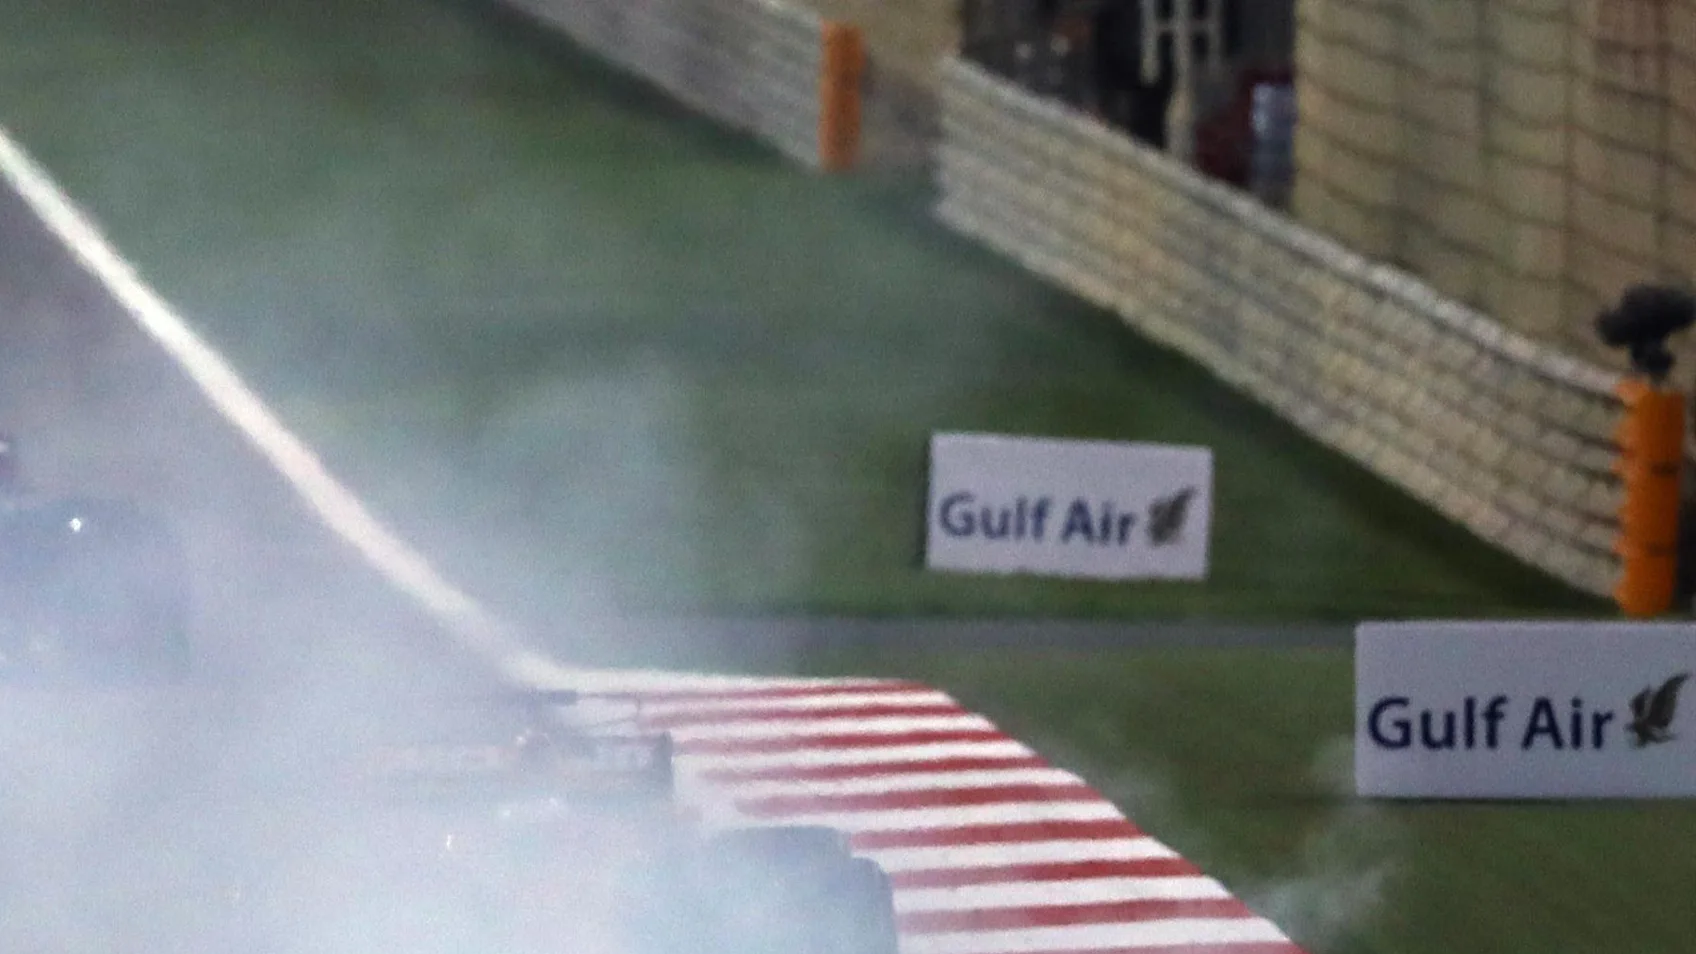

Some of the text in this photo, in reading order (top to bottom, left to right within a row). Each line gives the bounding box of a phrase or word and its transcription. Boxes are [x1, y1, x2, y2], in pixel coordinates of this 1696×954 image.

[939, 491, 1136, 546] Gulf Air
[1368, 696, 1615, 750] Gulf Air
